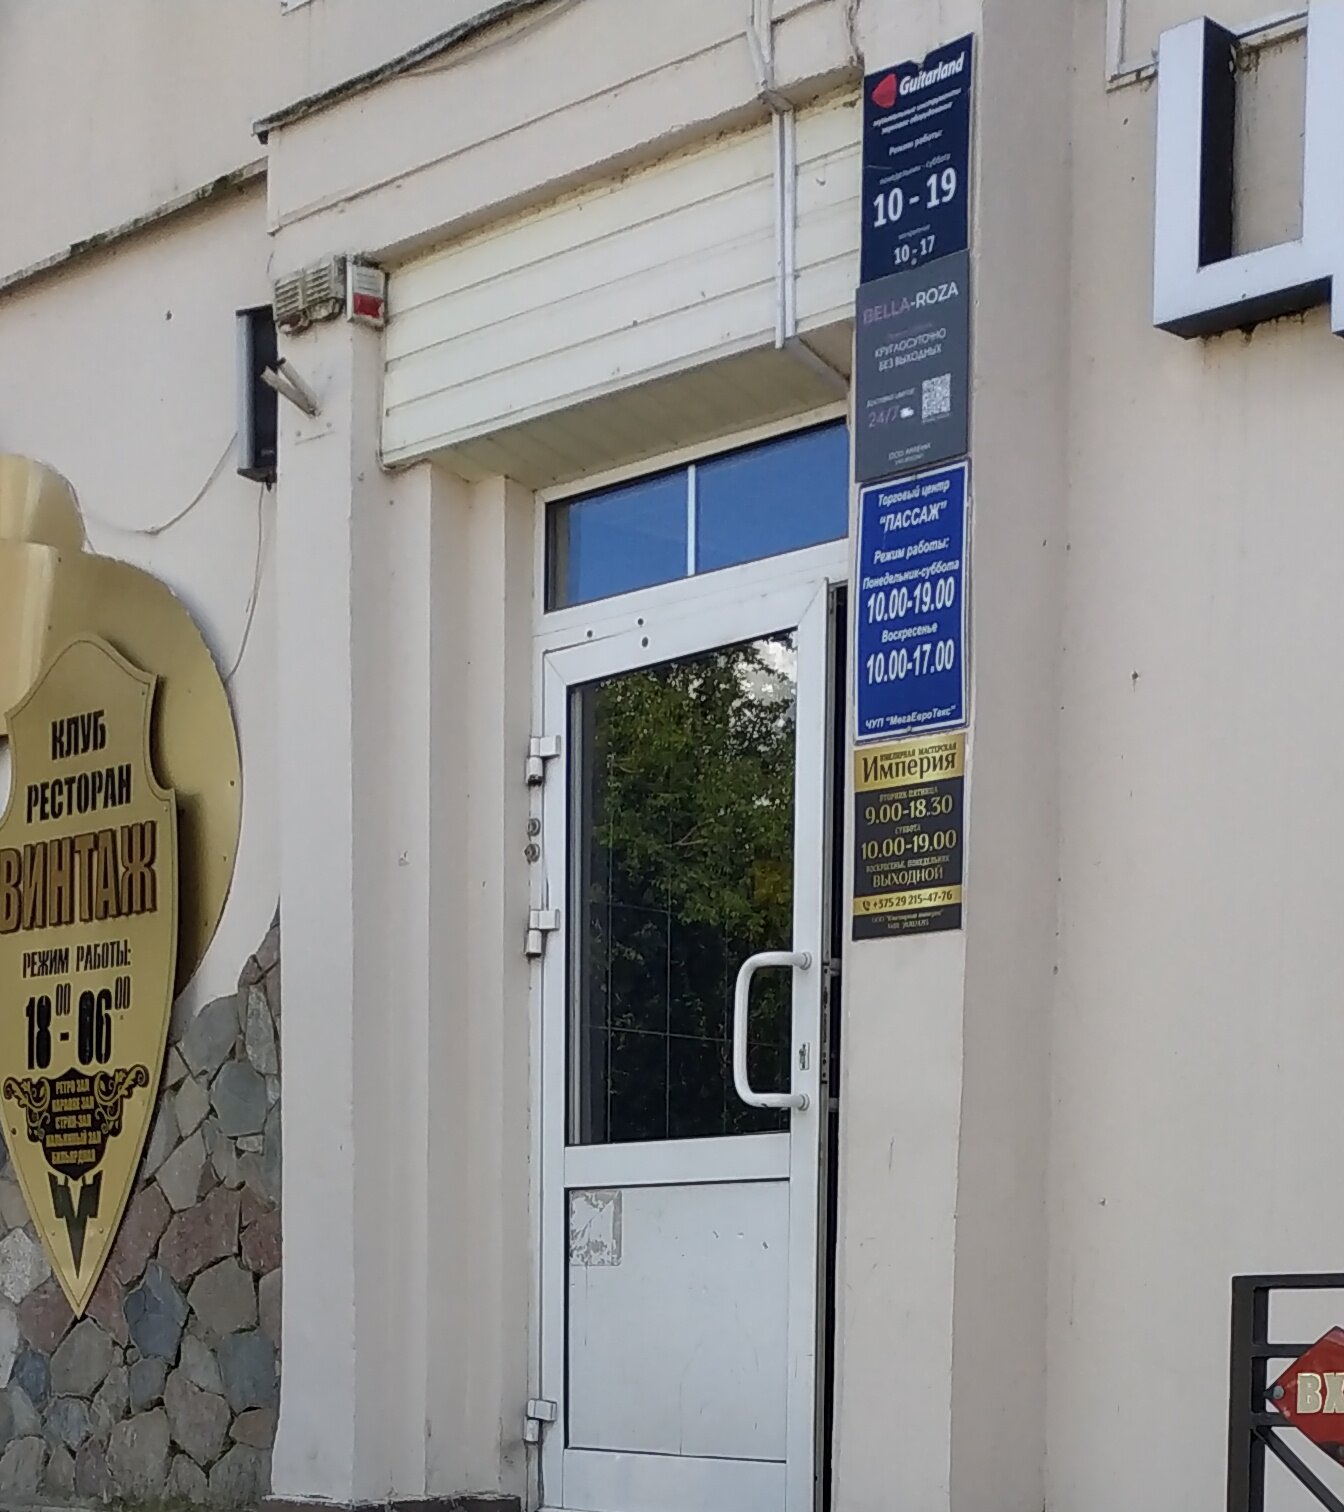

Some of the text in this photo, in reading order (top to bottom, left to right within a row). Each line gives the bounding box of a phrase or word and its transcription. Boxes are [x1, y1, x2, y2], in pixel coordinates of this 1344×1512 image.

[899, 51, 966, 96] Guitarland
[873, 187, 903, 228] 10
[926, 167, 956, 209] 19
[894, 244, 910, 265] 10
[920, 234, 935, 255] 17
[862, 281, 959, 325] BELLA-ROZA
[878, 480, 950, 507] Торговый центр
[873, 537, 949, 564] Режим работы:
[862, 560, 960, 590] Понедельник-суббота
[867, 576, 955, 624] 10.00-19.00
[881, 622, 938, 643] Воскресенье
[866, 639, 955, 685] 10.00-17.00
[51, 709, 106, 760] КЛУБ
[865, 717, 884, 730] ЧУП
[918, 742, 957, 756] МАСТЕРСКАЯ
[862, 752, 957, 783] Империя
[26, 764, 132, 824] РЕСТОРАН
[865, 794, 953, 825] 9.00-18.30
[861, 829, 956, 860] 10.00-19.00
[873, 865, 944, 888] ВЫХОДНОЙ
[896, 895, 906, 906] 29
[22, 939, 132, 978] РЕЖИМ РАБОТЫ:
[26, 995, 51, 1070] 18
[56, 983, 71, 1016] 00
[78, 988, 112, 1065] 06
[115, 975, 131, 1010] 00
